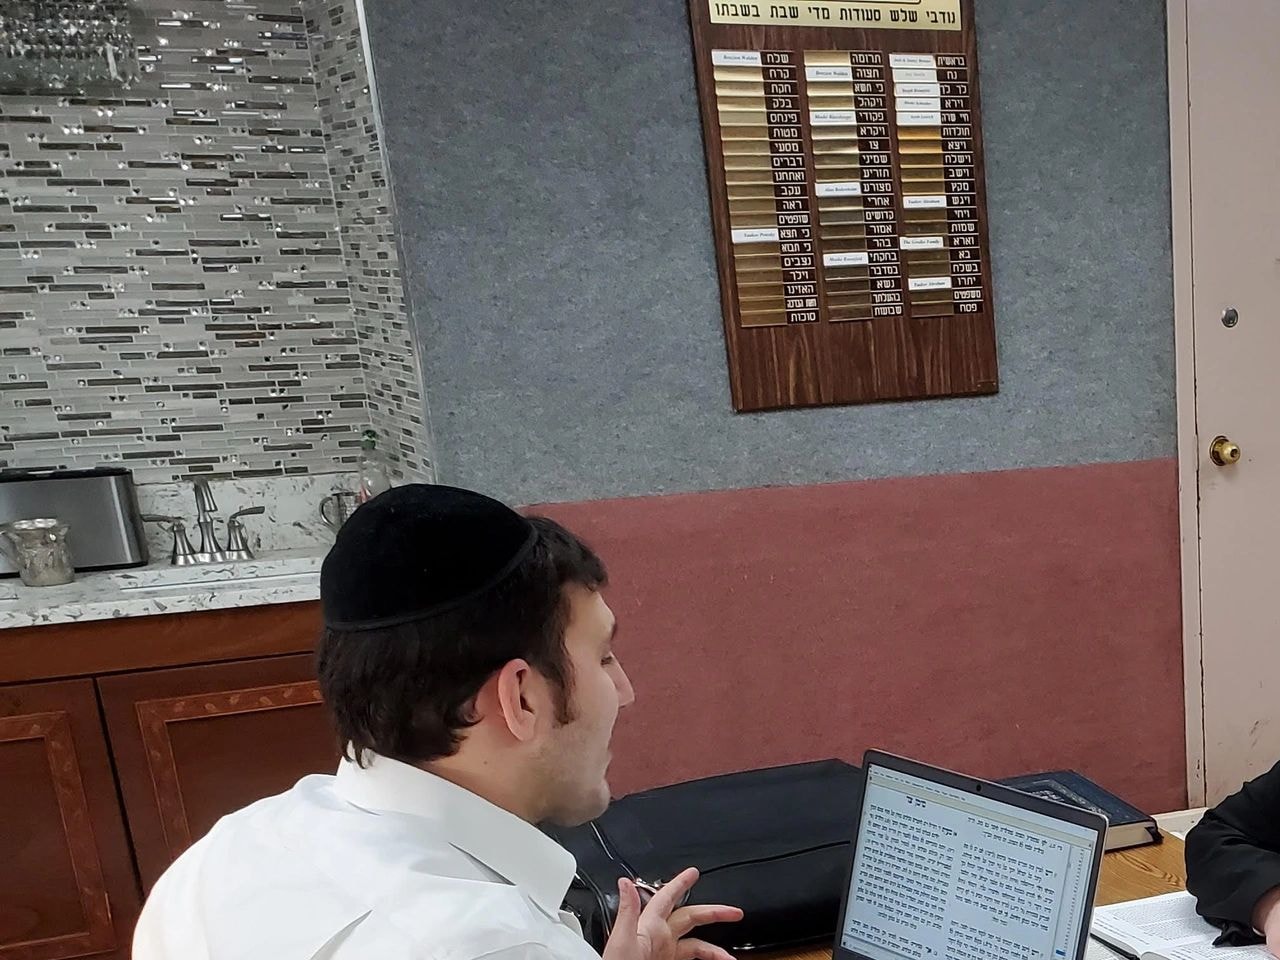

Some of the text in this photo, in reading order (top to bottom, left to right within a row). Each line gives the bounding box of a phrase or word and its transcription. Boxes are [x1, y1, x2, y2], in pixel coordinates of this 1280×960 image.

[716, 3, 956, 24] נודבי שלש סעודות מדי שבת בשבתו
[767, 54, 789, 63] שלח
[852, 54, 881, 63] תרומה
[938, 56, 965, 66] בראשית
[769, 69, 789, 78] קרח
[856, 68, 879, 78] תצוה
[947, 70, 957, 80] נח
[771, 84, 791, 93] חקת
[855, 83, 883, 92] כי תשא
[940, 85, 950, 94] לך
[956, 85, 967, 94] לך
[773, 99, 792, 108] בלק
[858, 97, 883, 107] ויקהל
[945, 99, 964, 108] וירא
[770, 113, 797, 122] פינחס
[860, 112, 884, 122] פקודי
[942, 113, 956, 122] שרה
[773, 129, 798, 137] מטות
[860, 126, 885, 136] ויקרא
[943, 127, 970, 137] תולדות
[775, 143, 798, 152] מסעי
[869, 141, 879, 149] צו
[948, 141, 966, 150] ויצא
[773, 157, 802, 166] דברים
[863, 154, 887, 164] שמיני
[945, 154, 971, 164] וישלח
[775, 172, 804, 181] ואתחנן
[863, 169, 889, 178] תזריע
[949, 168, 969, 178] וישב
[780, 186, 801, 195] עקב
[864, 182, 891, 192] מצורע
[951, 182, 969, 192] מקץ
[783, 200, 802, 209] ראה
[867, 197, 890, 206] אחרי
[952, 196, 970, 205] ויגש
[866, 211, 894, 220] קדושים
[954, 210, 970, 218] ויחי
[779, 215, 808, 224] שופטים
[869, 225, 892, 234] אמור
[951, 223, 975, 232] שמות
[780, 229, 797, 238] תצא
[802, 229, 810, 237] כי
[873, 239, 891, 247] בהר
[953, 237, 974, 246] וארא
[782, 243, 811, 252] כי תבוא
[869, 252, 897, 261] בחקתי
[958, 250, 971, 259] בא
[784, 257, 811, 266] נצבים
[871, 266, 898, 275] במדבר
[953, 263, 978, 272] בשלח
[790, 271, 808, 280] וילך
[877, 280, 894, 289] נשא
[957, 277, 976, 285] יתרו
[787, 285, 814, 294] האזינו
[873, 293, 900, 302] בהעלתך
[954, 290, 981, 299] משפטים
[874, 306, 902, 316] שבועות
[960, 303, 977, 312] פסח
[791, 312, 816, 322] סוכות
